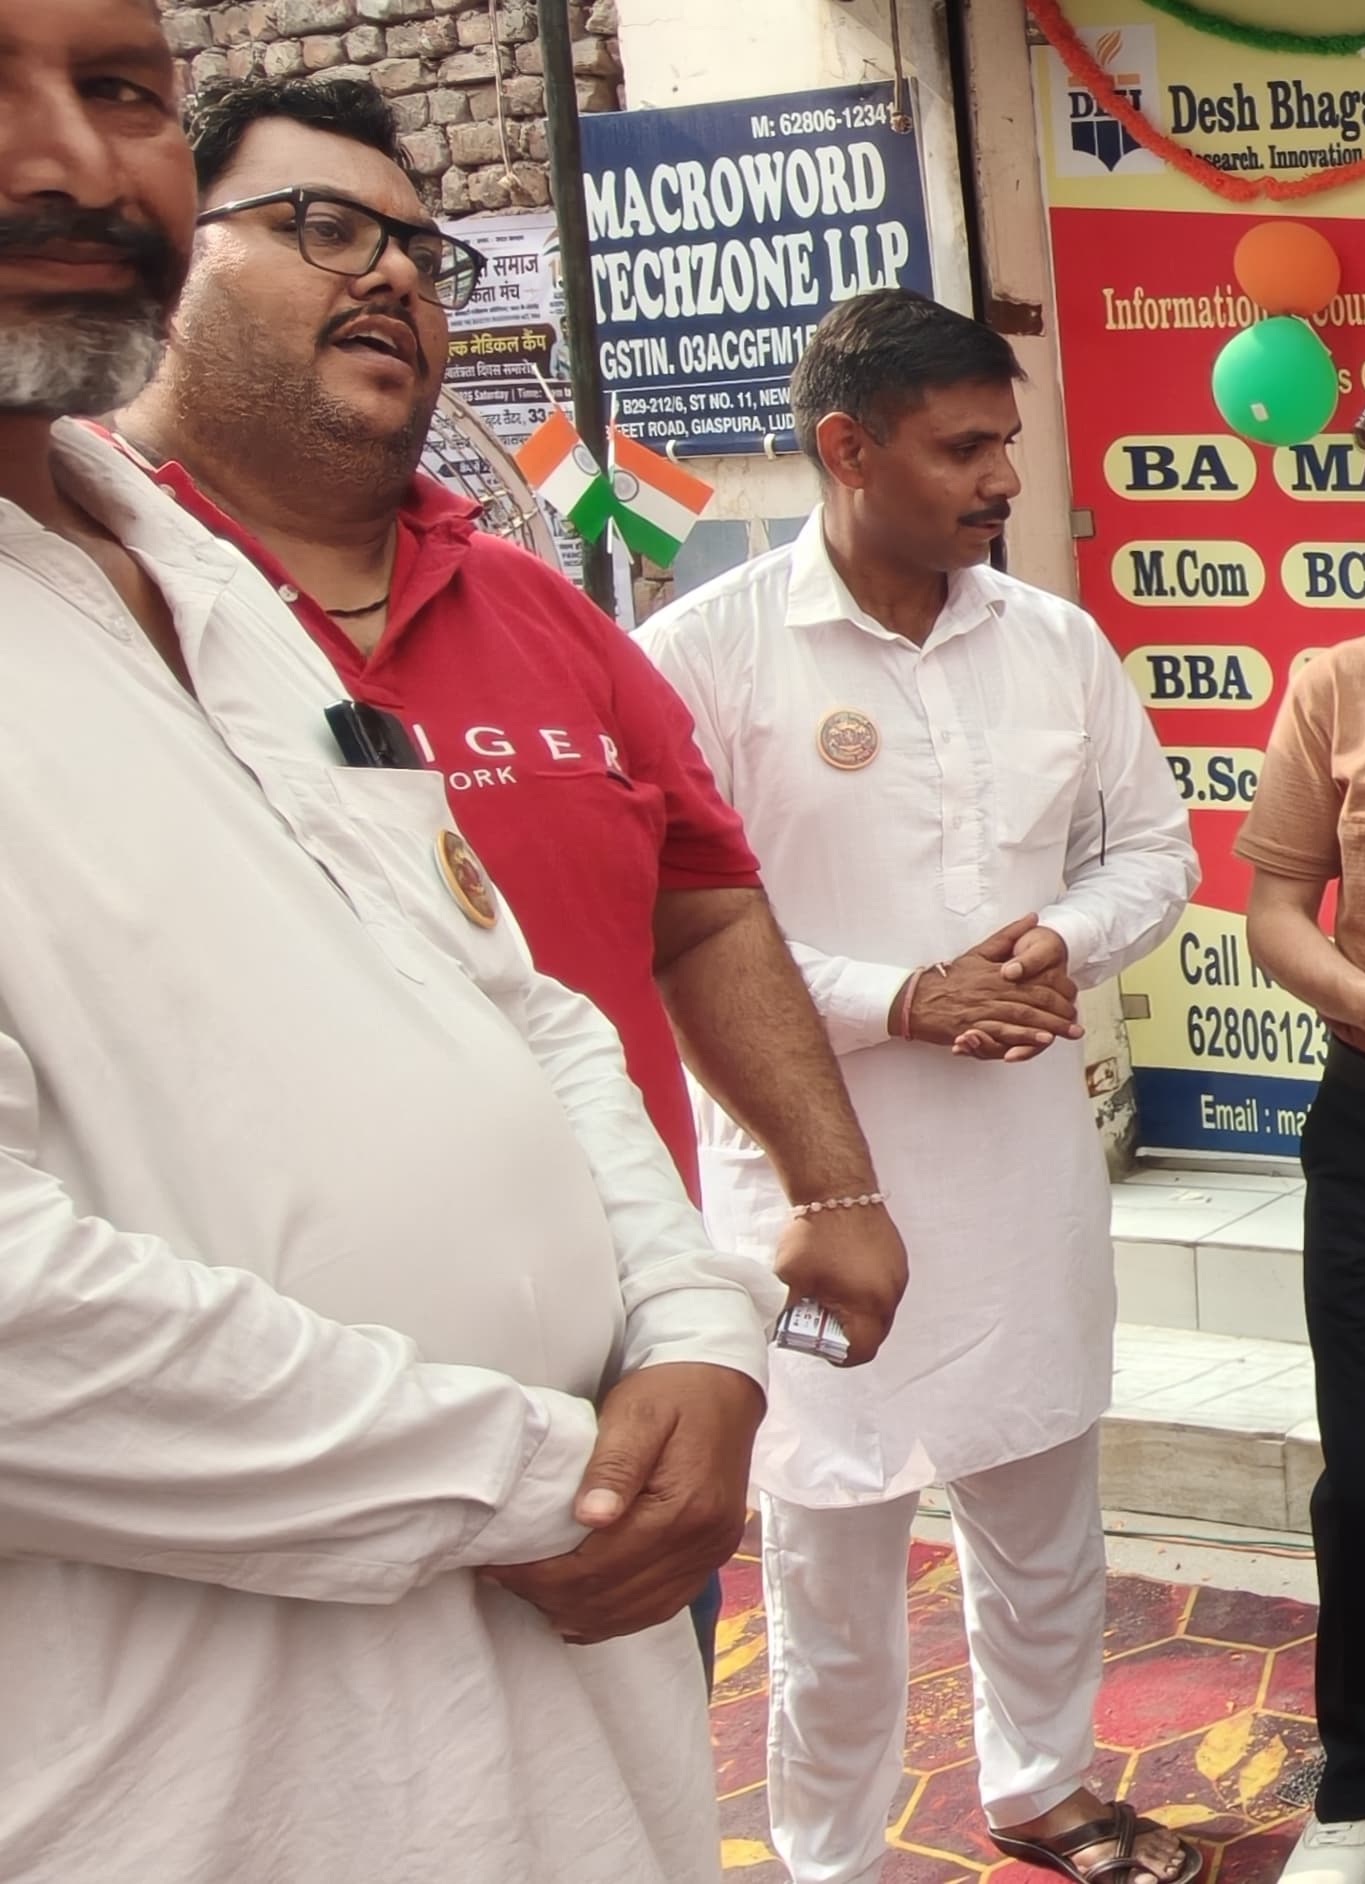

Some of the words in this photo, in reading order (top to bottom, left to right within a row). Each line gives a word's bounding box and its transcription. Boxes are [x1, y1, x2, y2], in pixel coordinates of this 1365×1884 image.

[751, 115, 777, 139] M:
[1168, 82, 1260, 134] Desh
[582, 140, 886, 242] MACROWORD
[492, 253, 539, 277] समाज
[823, 220, 909, 303] LLP
[500, 280, 520, 301] मंच
[600, 336, 676, 381] GSTIN.
[528, 408, 546, 423] 33
[622, 395, 688, 415] B29-212/6,
[690, 393, 708, 411] ST
[709, 392, 735, 410] NO.
[737, 391, 758, 411] 11,
[648, 419, 690, 438] ROAD,
[691, 416, 767, 436] GIASPURA,
[1122, 444, 1239, 491] BA
[1130, 550, 1249, 598] M.Com
[1147, 654, 1253, 700] BBA
[412, 723, 622, 772] IGER
[448, 766, 517, 791] ORK
[1179, 931, 1240, 987] Call
[1187, 1004, 1331, 1065] 62806123
[1200, 1094, 1259, 1133] Email
